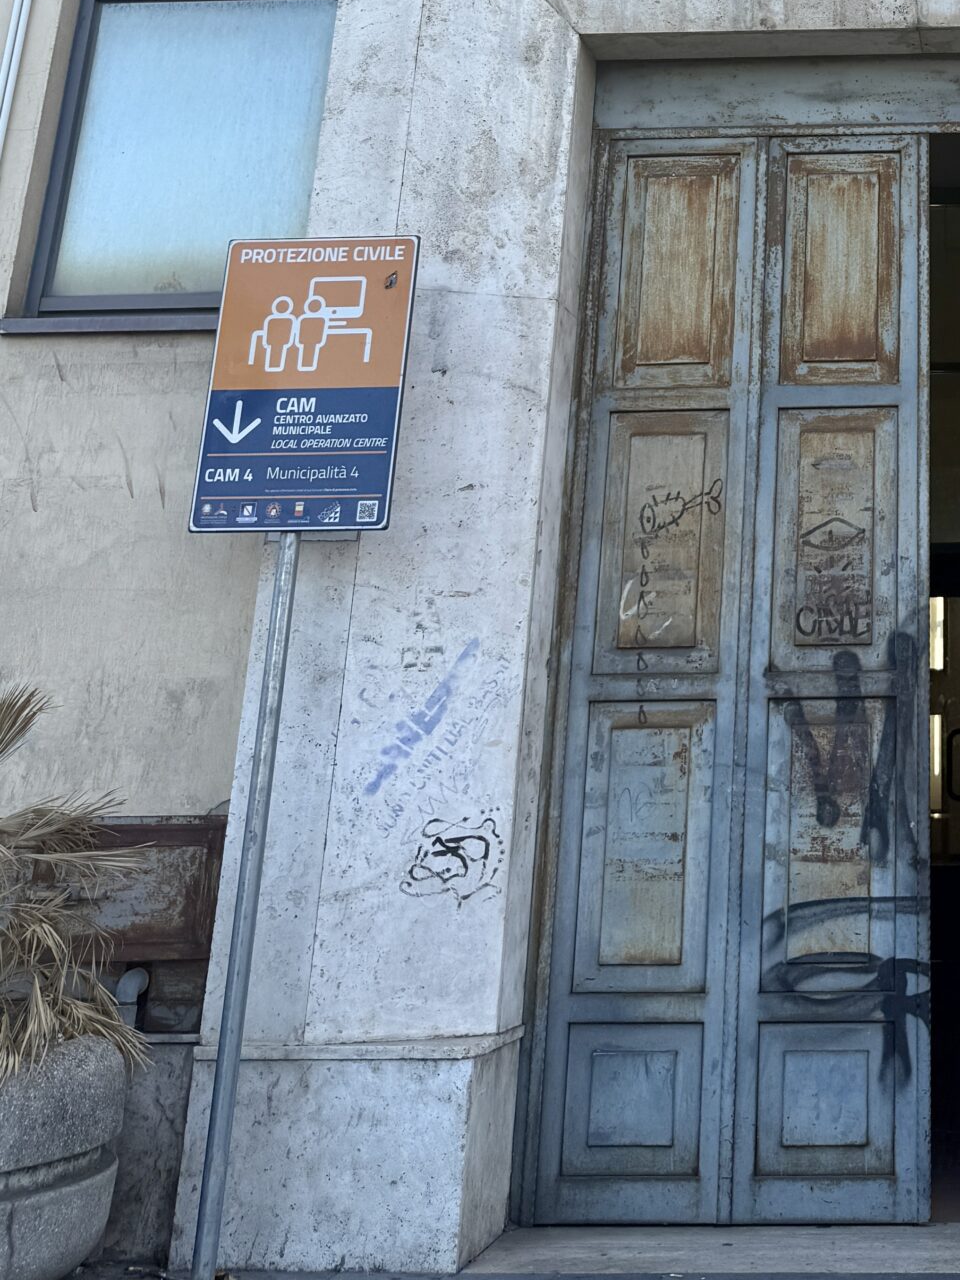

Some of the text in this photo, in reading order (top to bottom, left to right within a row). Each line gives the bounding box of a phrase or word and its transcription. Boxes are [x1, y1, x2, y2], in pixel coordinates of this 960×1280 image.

[240, 245, 406, 264] PROTEZIONE CIVILE
[275, 397, 317, 413] CAM
[273, 413, 369, 425] CENTRO AVANZATO
[272, 425, 333, 435] MUNICIPALE
[270, 437, 389, 449] LOCAL OPERATION CENTRE
[204, 465, 360, 483] CAM 4 Municipalità 4
